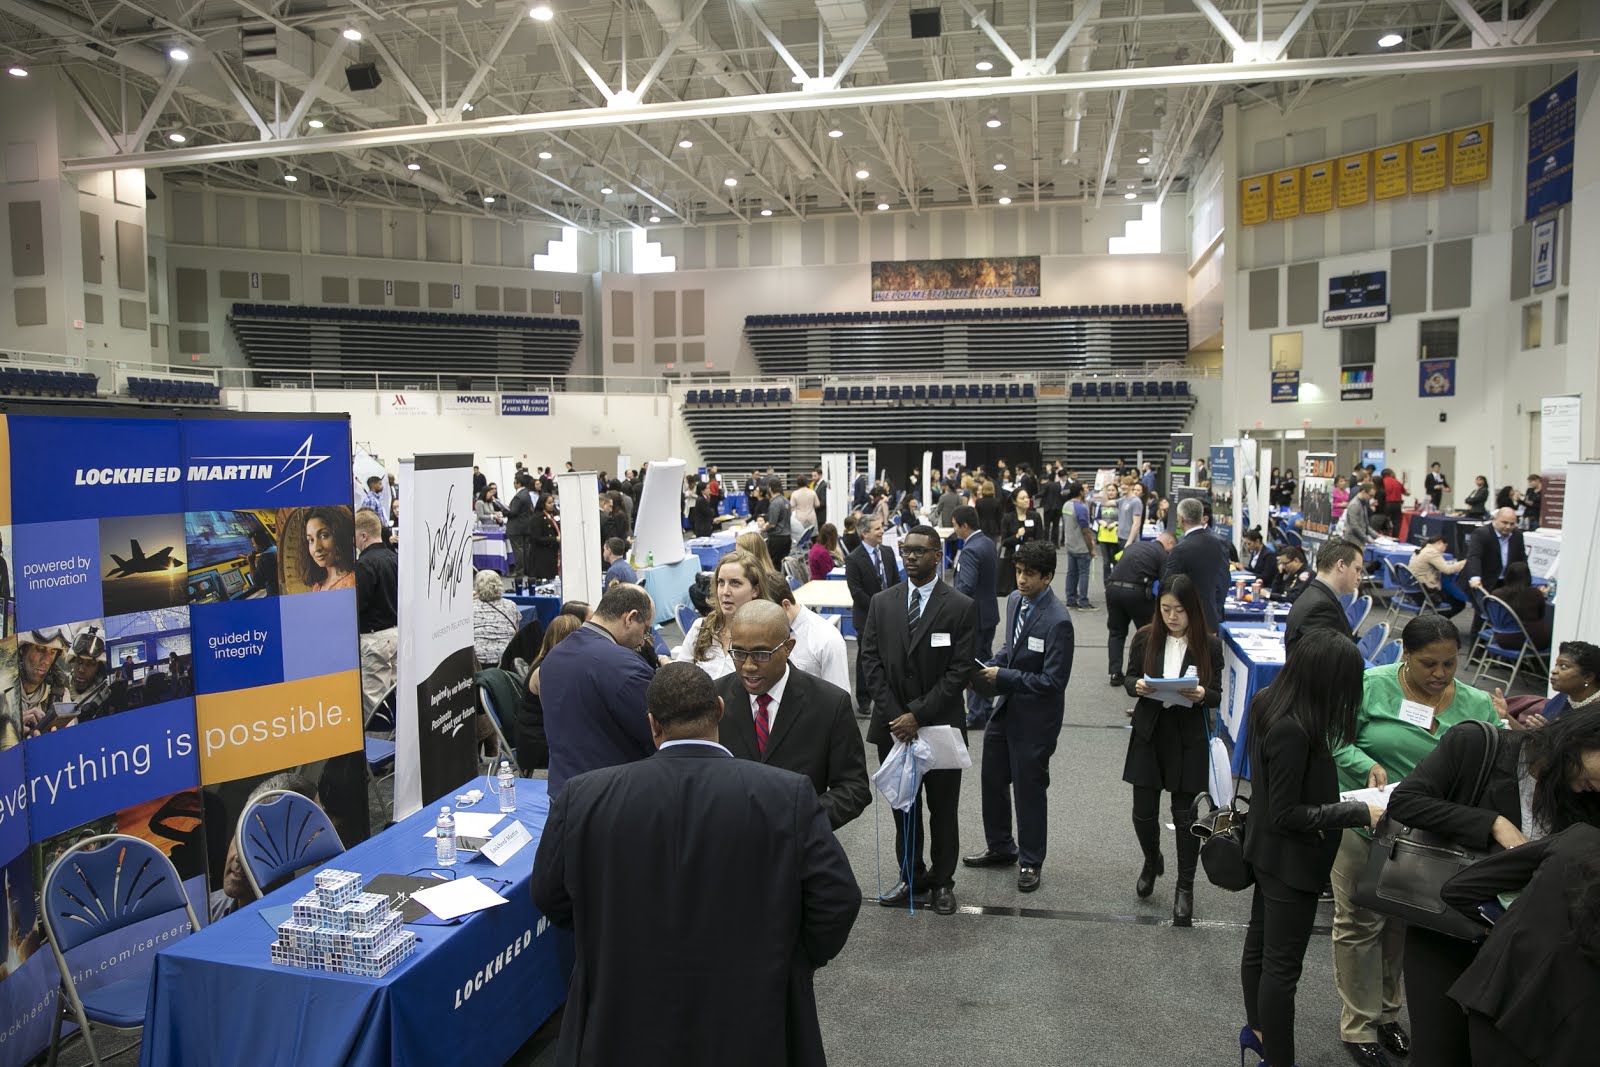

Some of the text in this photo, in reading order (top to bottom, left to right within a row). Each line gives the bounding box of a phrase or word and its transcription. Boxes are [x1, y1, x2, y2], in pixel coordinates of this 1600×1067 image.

[457, 395, 492, 404] HOWELL
[502, 404, 521, 412] JAMES
[75, 464, 273, 486] LOCKHEED MARTIN
[24, 556, 91, 577] powered by
[29, 572, 87, 590] innovation
[208, 630, 268, 649] guided by
[214, 642, 264, 659] integrity
[167, 730, 192, 759] is
[205, 701, 352, 757] possible.
[490, 829, 519, 854] Lockheed Martin
[454, 928, 532, 1010] LOCKHEED
